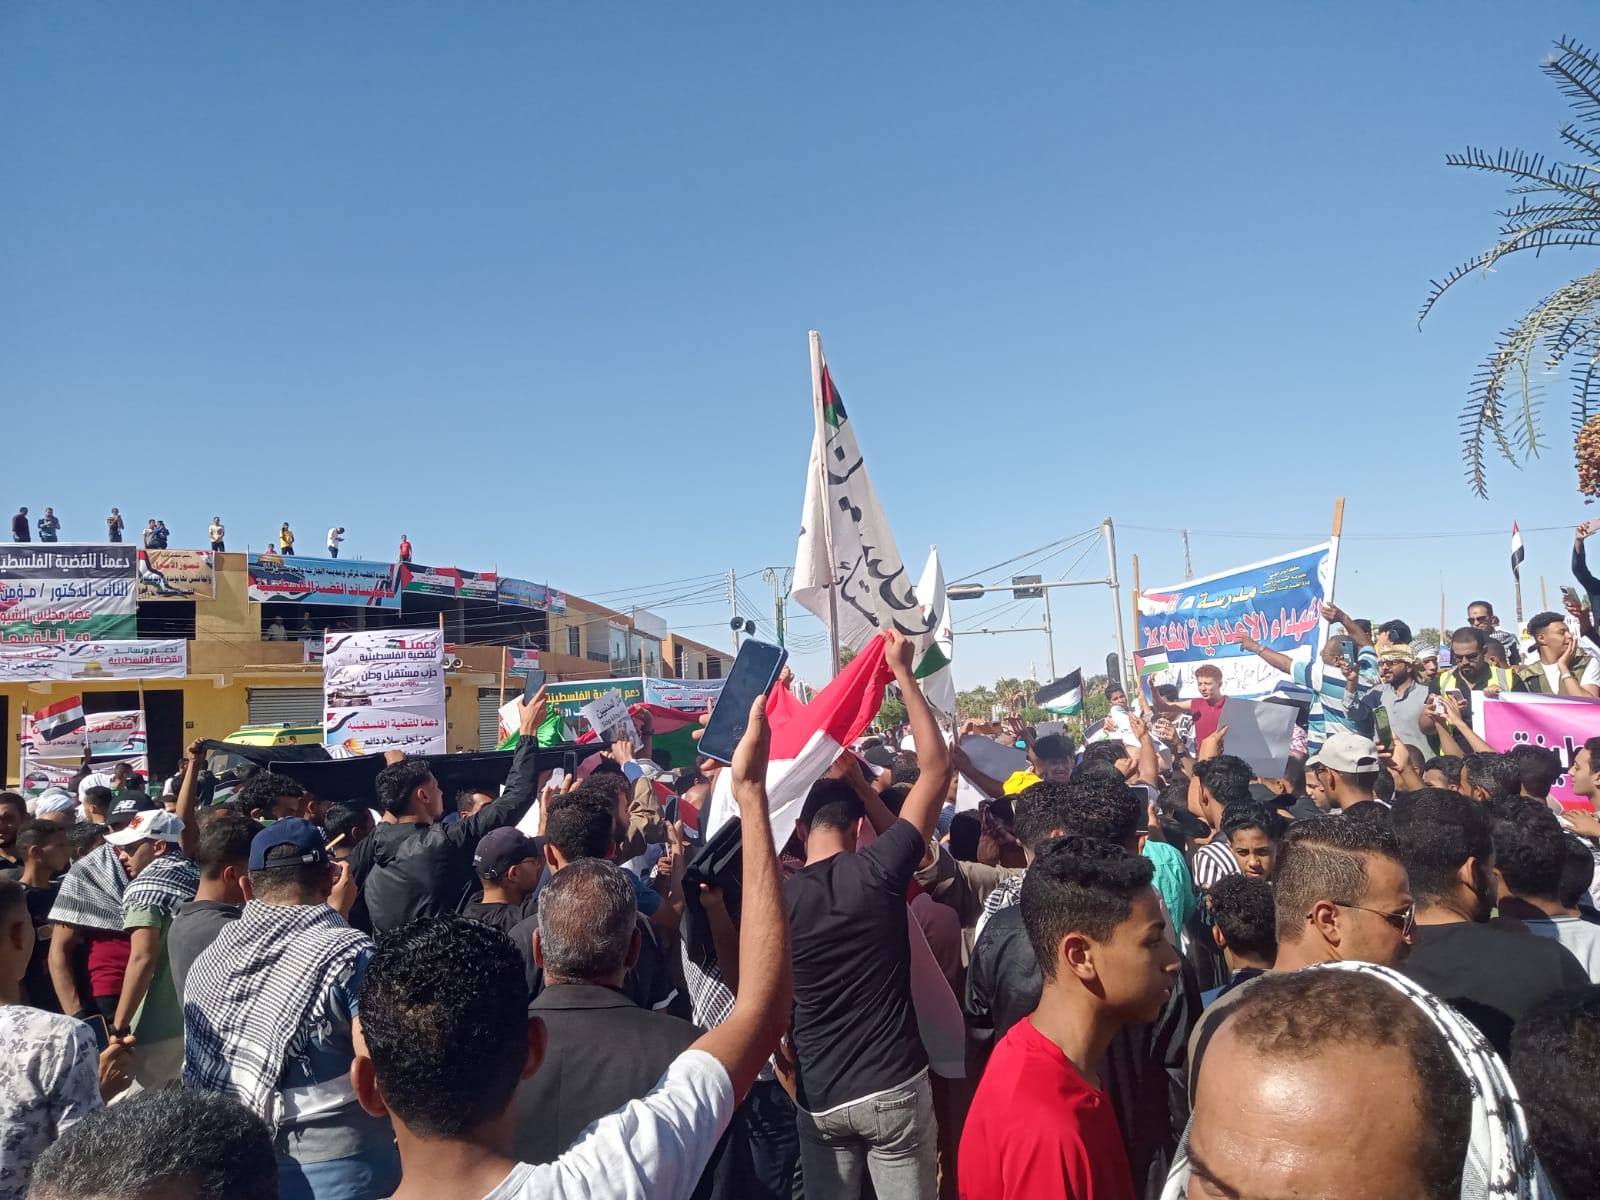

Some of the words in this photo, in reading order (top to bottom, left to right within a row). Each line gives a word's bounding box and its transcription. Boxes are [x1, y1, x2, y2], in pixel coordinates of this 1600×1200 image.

[55, 553, 97, 572] للقضية
[100, 553, 130, 568] دعمنا
[50, 582, 92, 602] الدكتور
[95, 582, 128, 601] النائب
[1196, 585, 1258, 609] مدرسة
[33, 608, 66, 624] مجلس
[69, 609, 91, 623] عضو
[108, 656, 154, 665] الفلسطينية
[156, 655, 183, 665] القضية
[360, 651, 406, 662] الفلسطينية
[408, 650, 437, 661] للقضية
[361, 670, 383, 682] وطن
[383, 668, 420, 680] مستقبل
[420, 668, 438, 679] حزب
[625, 689, 640, 701] دعم
[348, 720, 389, 731] الفلسطينية
[392, 719, 418, 730] للقضية
[381, 735, 400, 747] سلام
[420, 736, 432, 745] من
